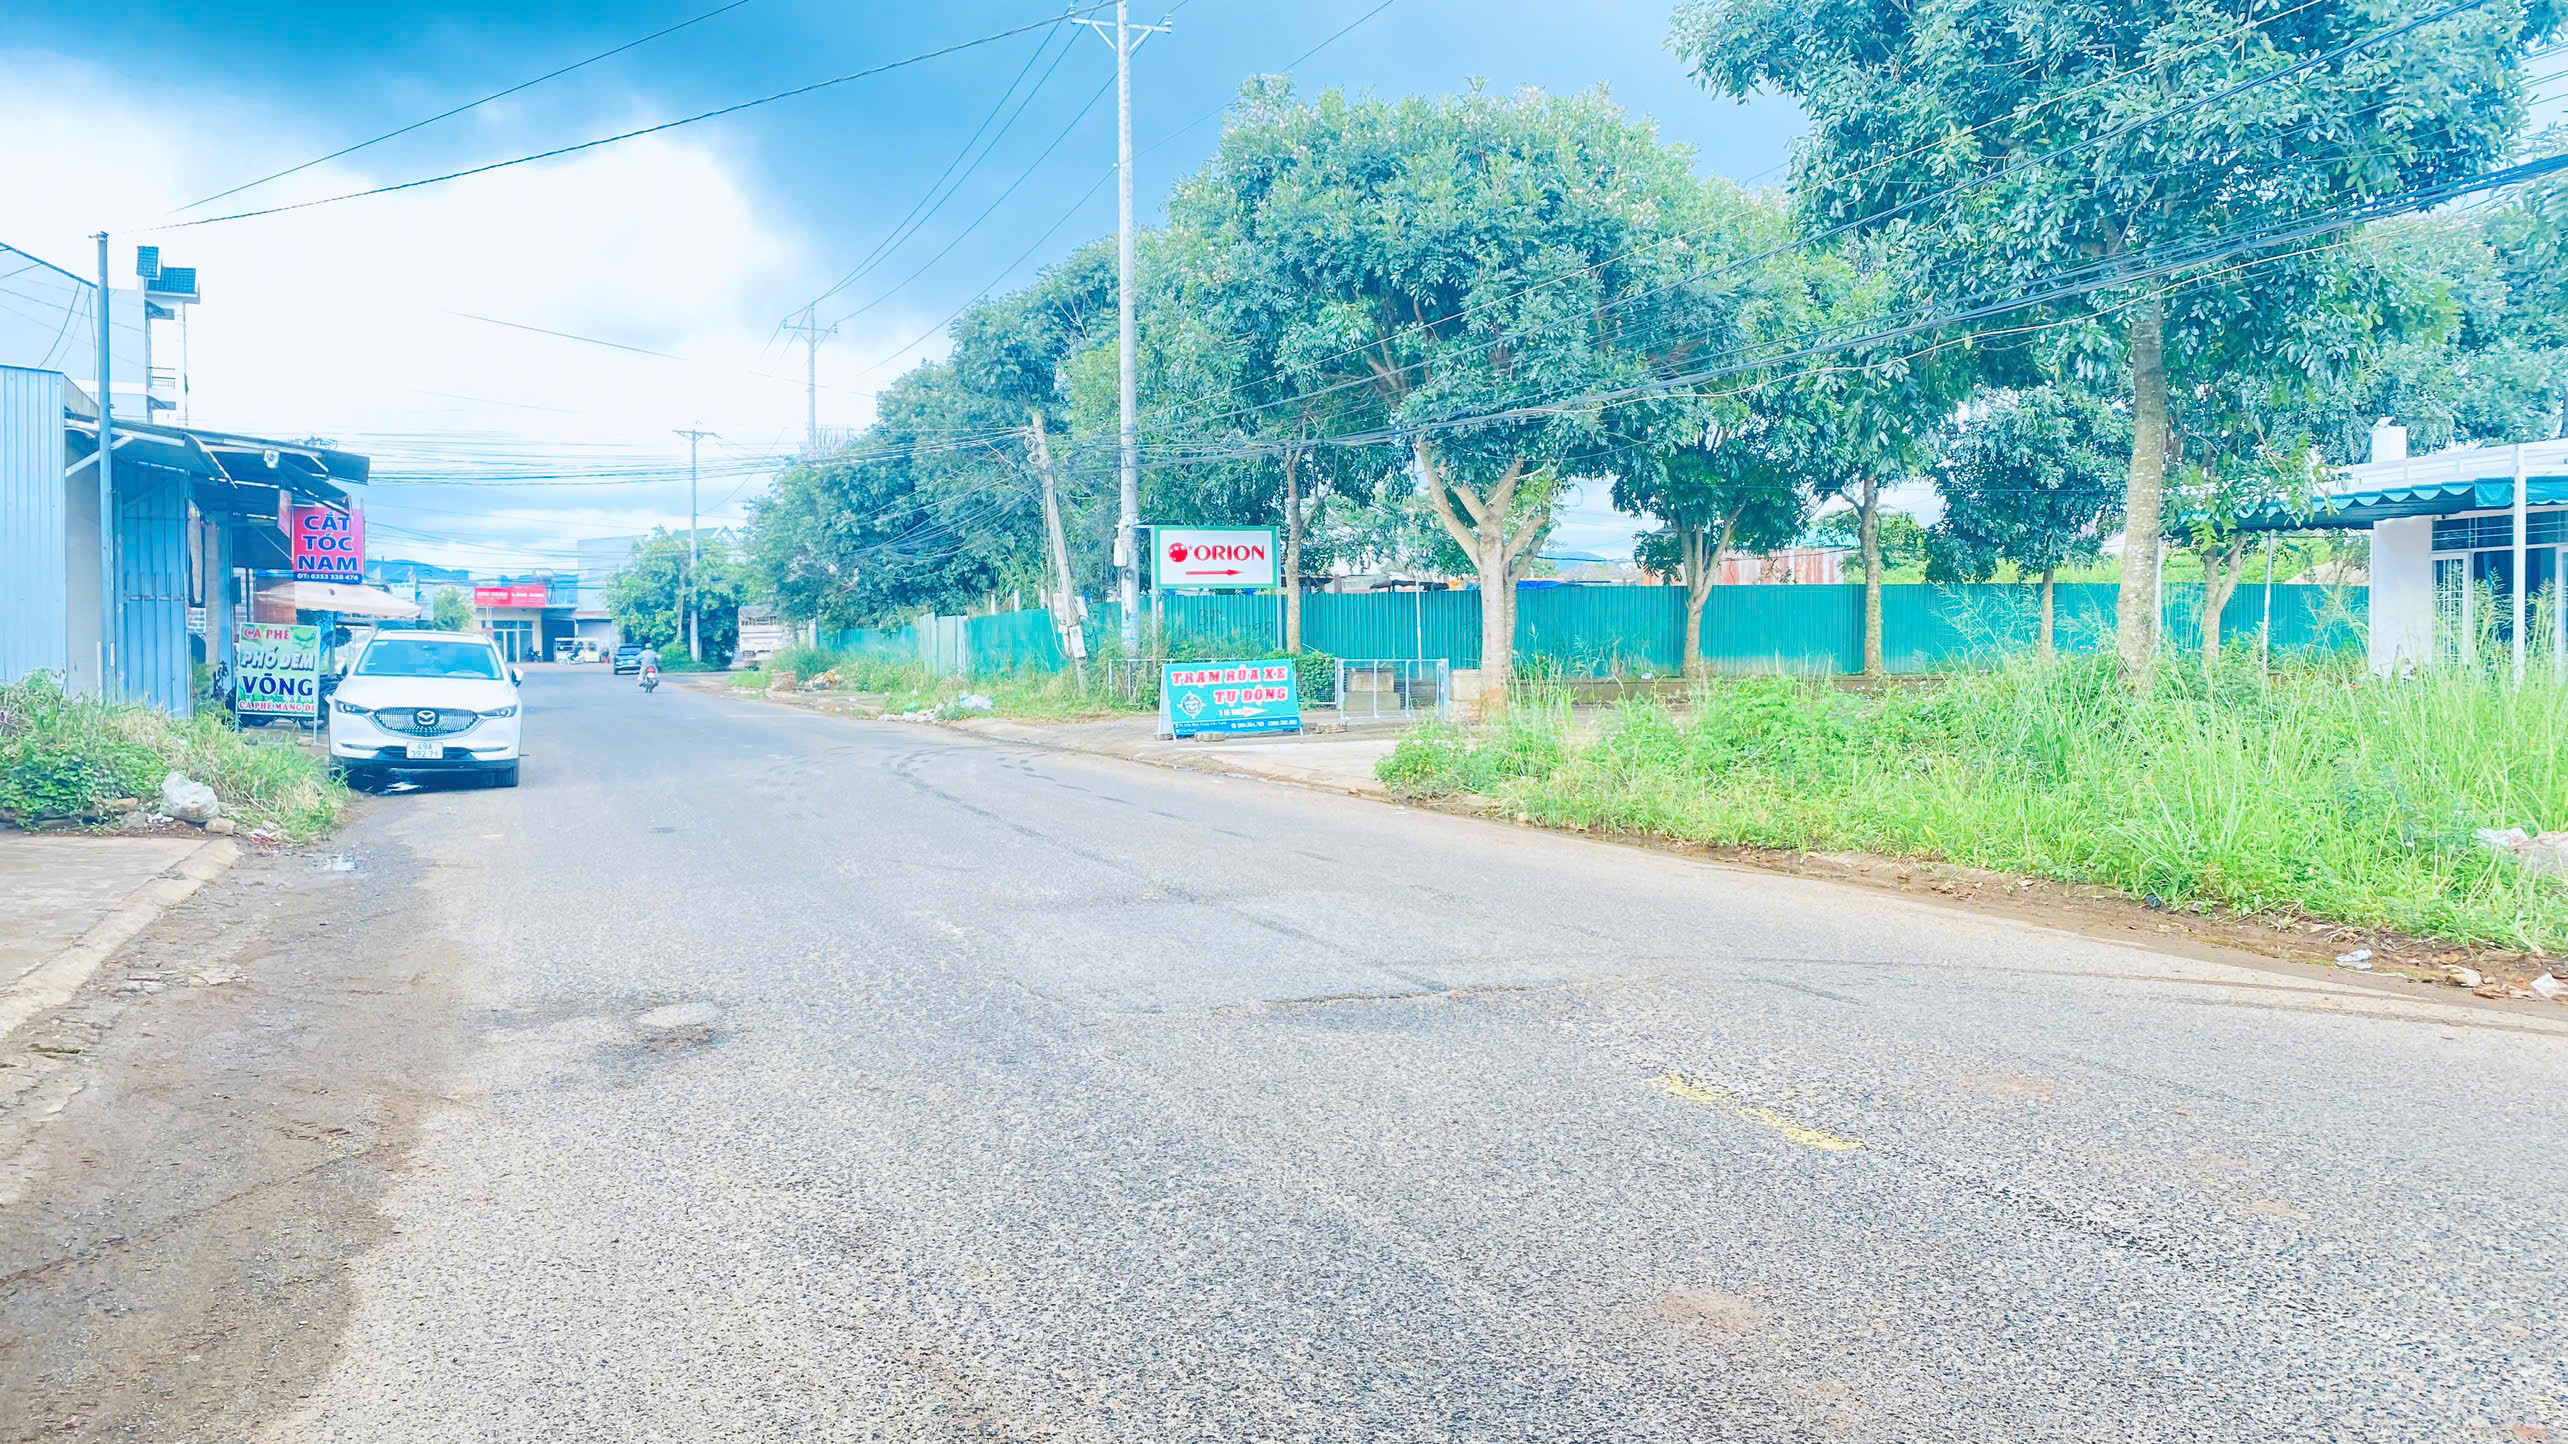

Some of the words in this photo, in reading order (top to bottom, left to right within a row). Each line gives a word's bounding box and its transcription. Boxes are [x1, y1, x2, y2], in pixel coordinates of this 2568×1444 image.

[304, 511, 350, 531] CẮT
[302, 533, 353, 551] TÓC
[1194, 545, 1265, 561] ORION
[298, 555, 358, 571] NAM
[1172, 671, 1221, 688] TRẠM
[1264, 667, 1287, 681] XE
